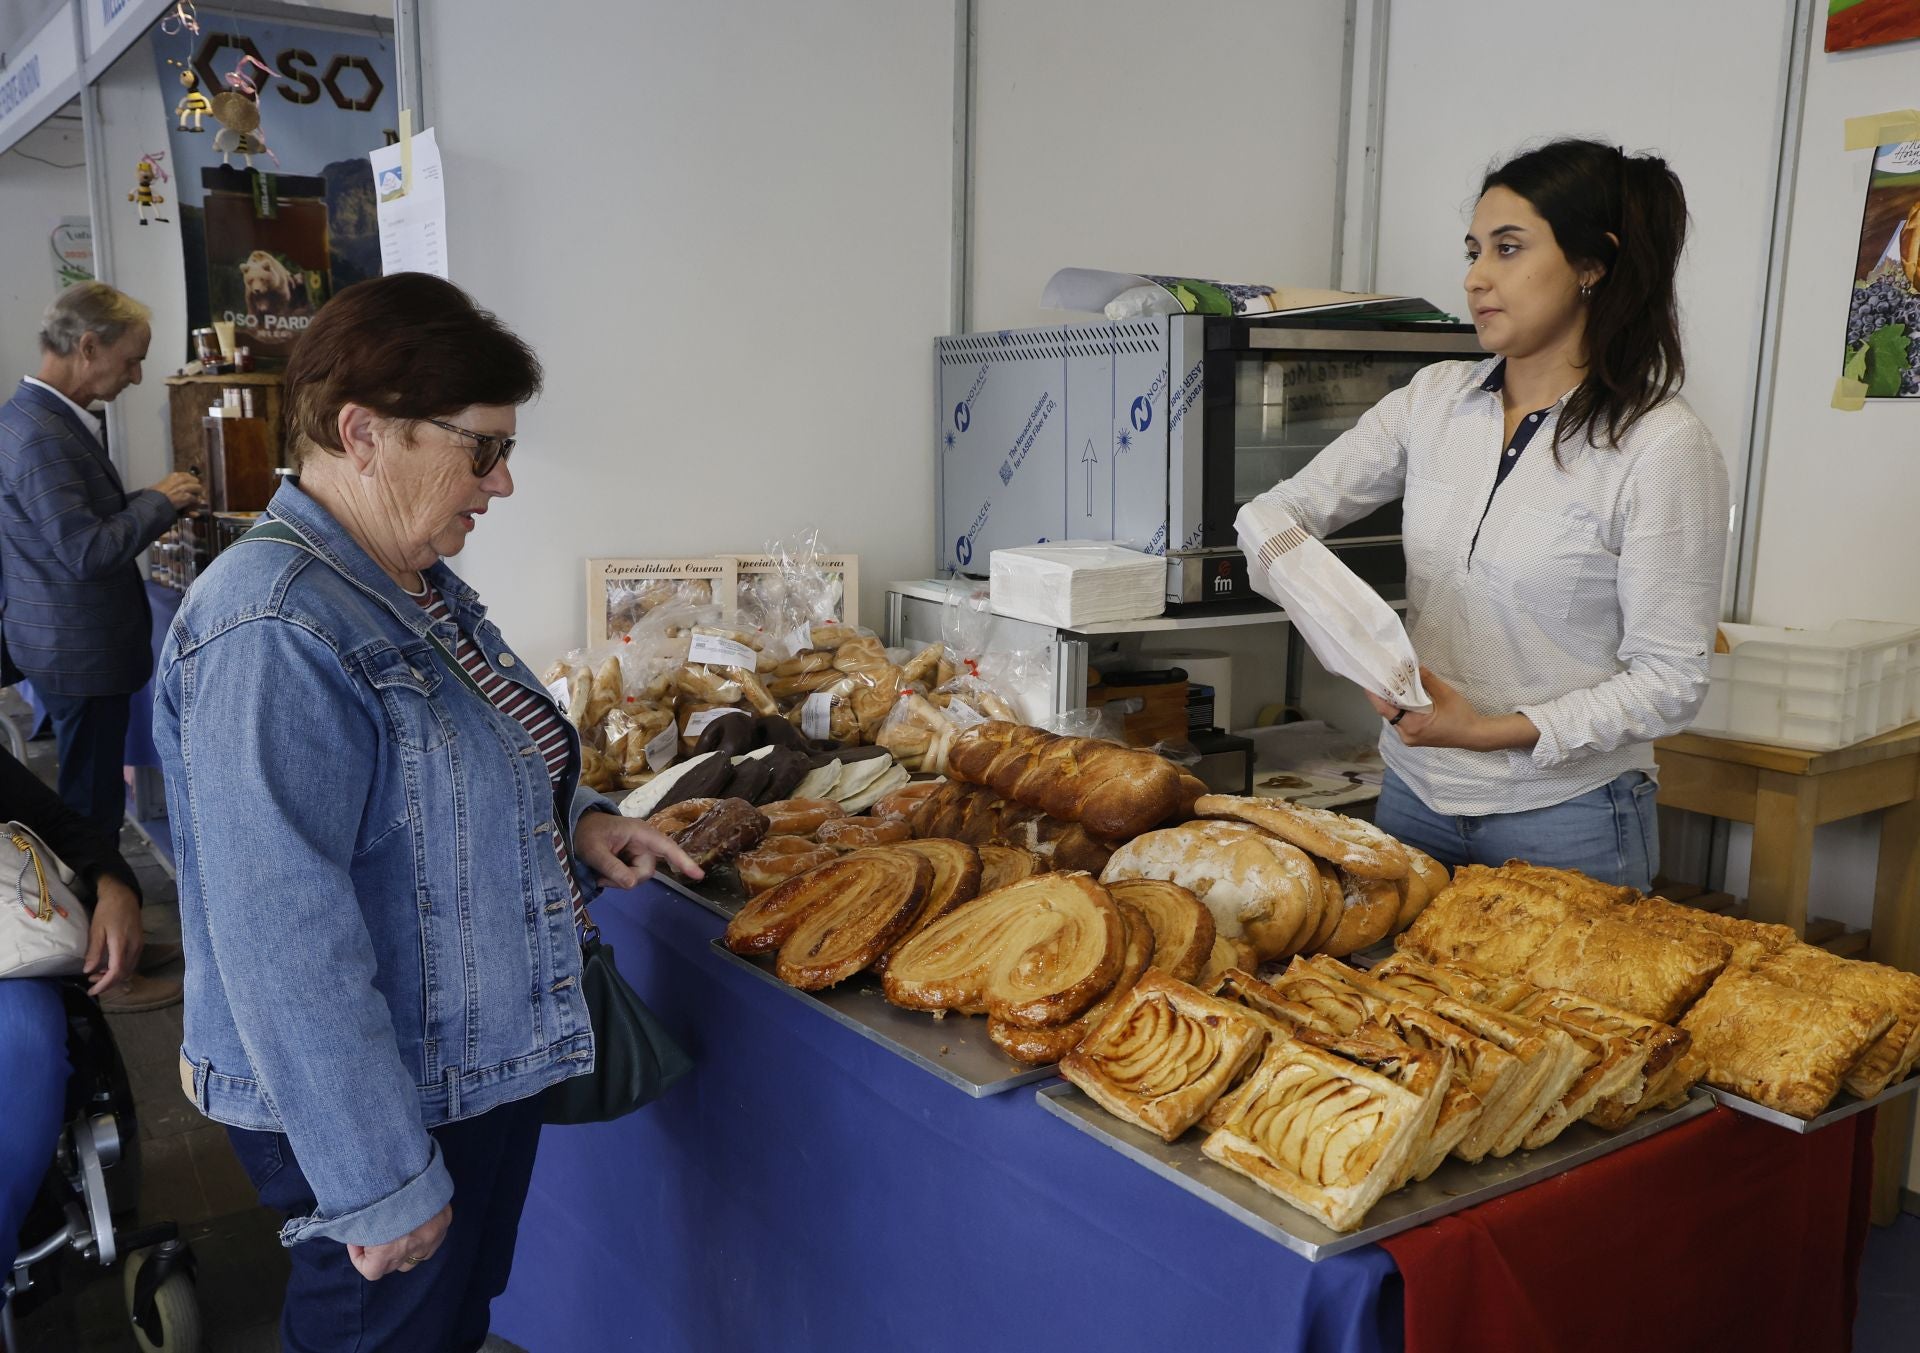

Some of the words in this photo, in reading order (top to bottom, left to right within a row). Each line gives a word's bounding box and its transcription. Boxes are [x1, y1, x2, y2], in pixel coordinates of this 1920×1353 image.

[194, 32, 385, 112] OSO
[264, 315, 313, 330] PARD
[1147, 362, 1168, 400] NOVA
[1031, 391, 1049, 421] Solution
[968, 500, 991, 540] NOVACEL
[605, 563, 681, 575] Especialidades
[685, 563, 723, 573] Caseras
[1214, 576, 1232, 591] fm
